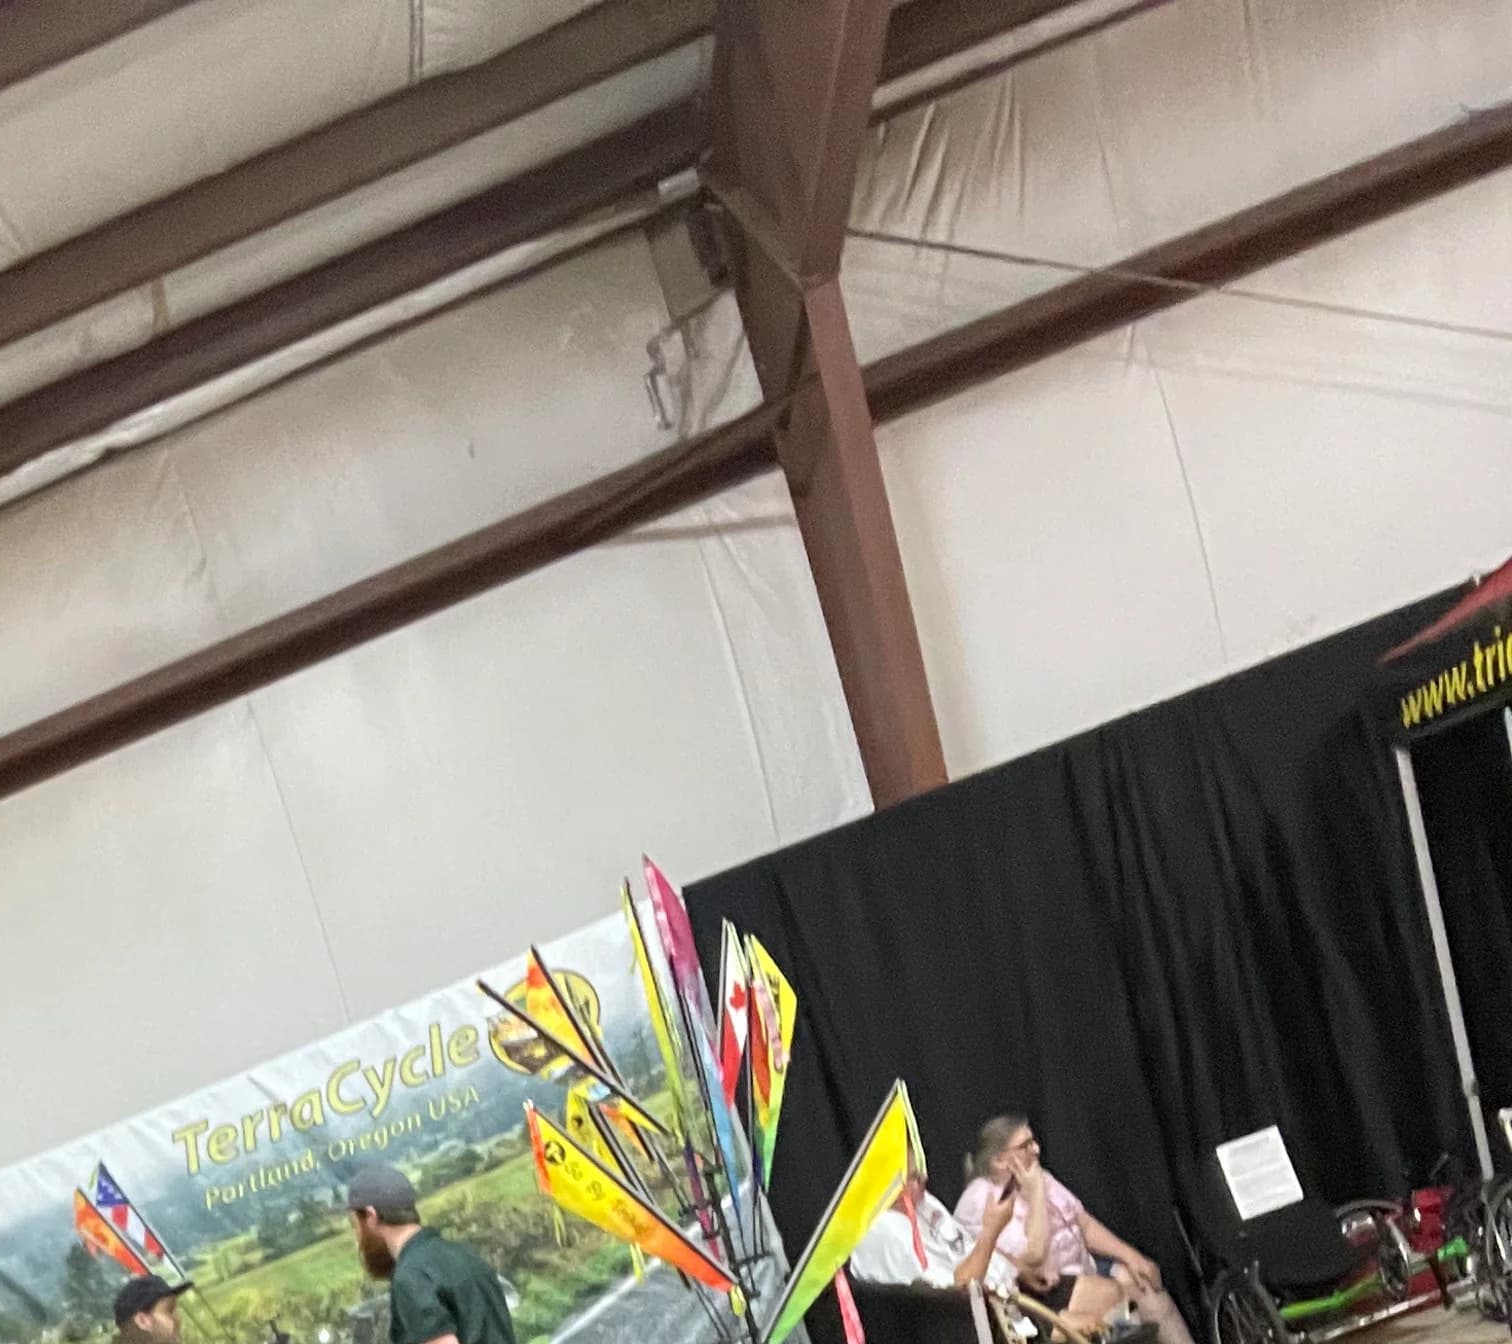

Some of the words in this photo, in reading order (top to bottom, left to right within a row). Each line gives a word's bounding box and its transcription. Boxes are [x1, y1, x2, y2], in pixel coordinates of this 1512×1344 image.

[172, 1023, 480, 1177] TerraCycle
[205, 1148, 322, 1211] Portland,
[327, 1110, 422, 1162] Oregon
[427, 1085, 481, 1121] USA
